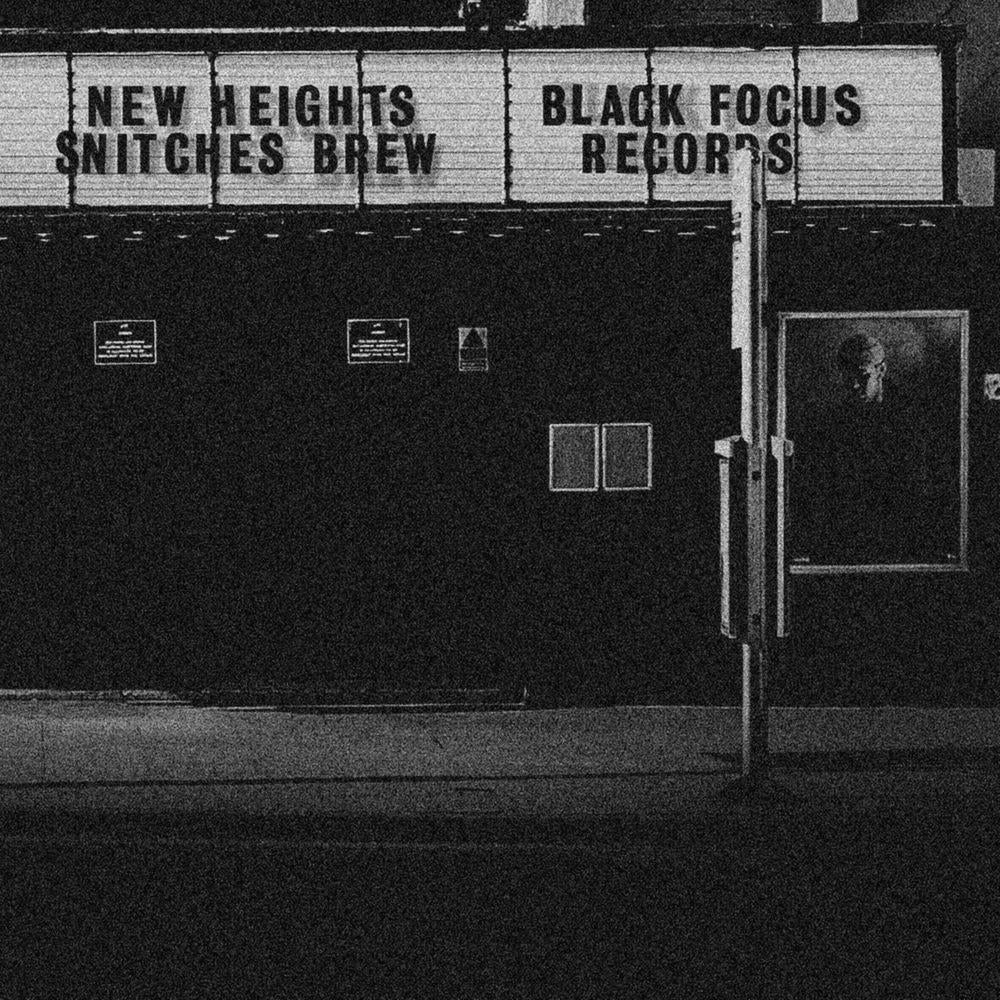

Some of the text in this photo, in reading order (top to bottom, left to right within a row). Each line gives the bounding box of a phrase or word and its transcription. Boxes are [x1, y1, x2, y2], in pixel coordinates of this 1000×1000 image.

[87, 84, 416, 127] NEW HEIGHTS
[542, 83, 862, 127] BLACK FOCUS
[55, 130, 437, 176] SNITCHES BREW
